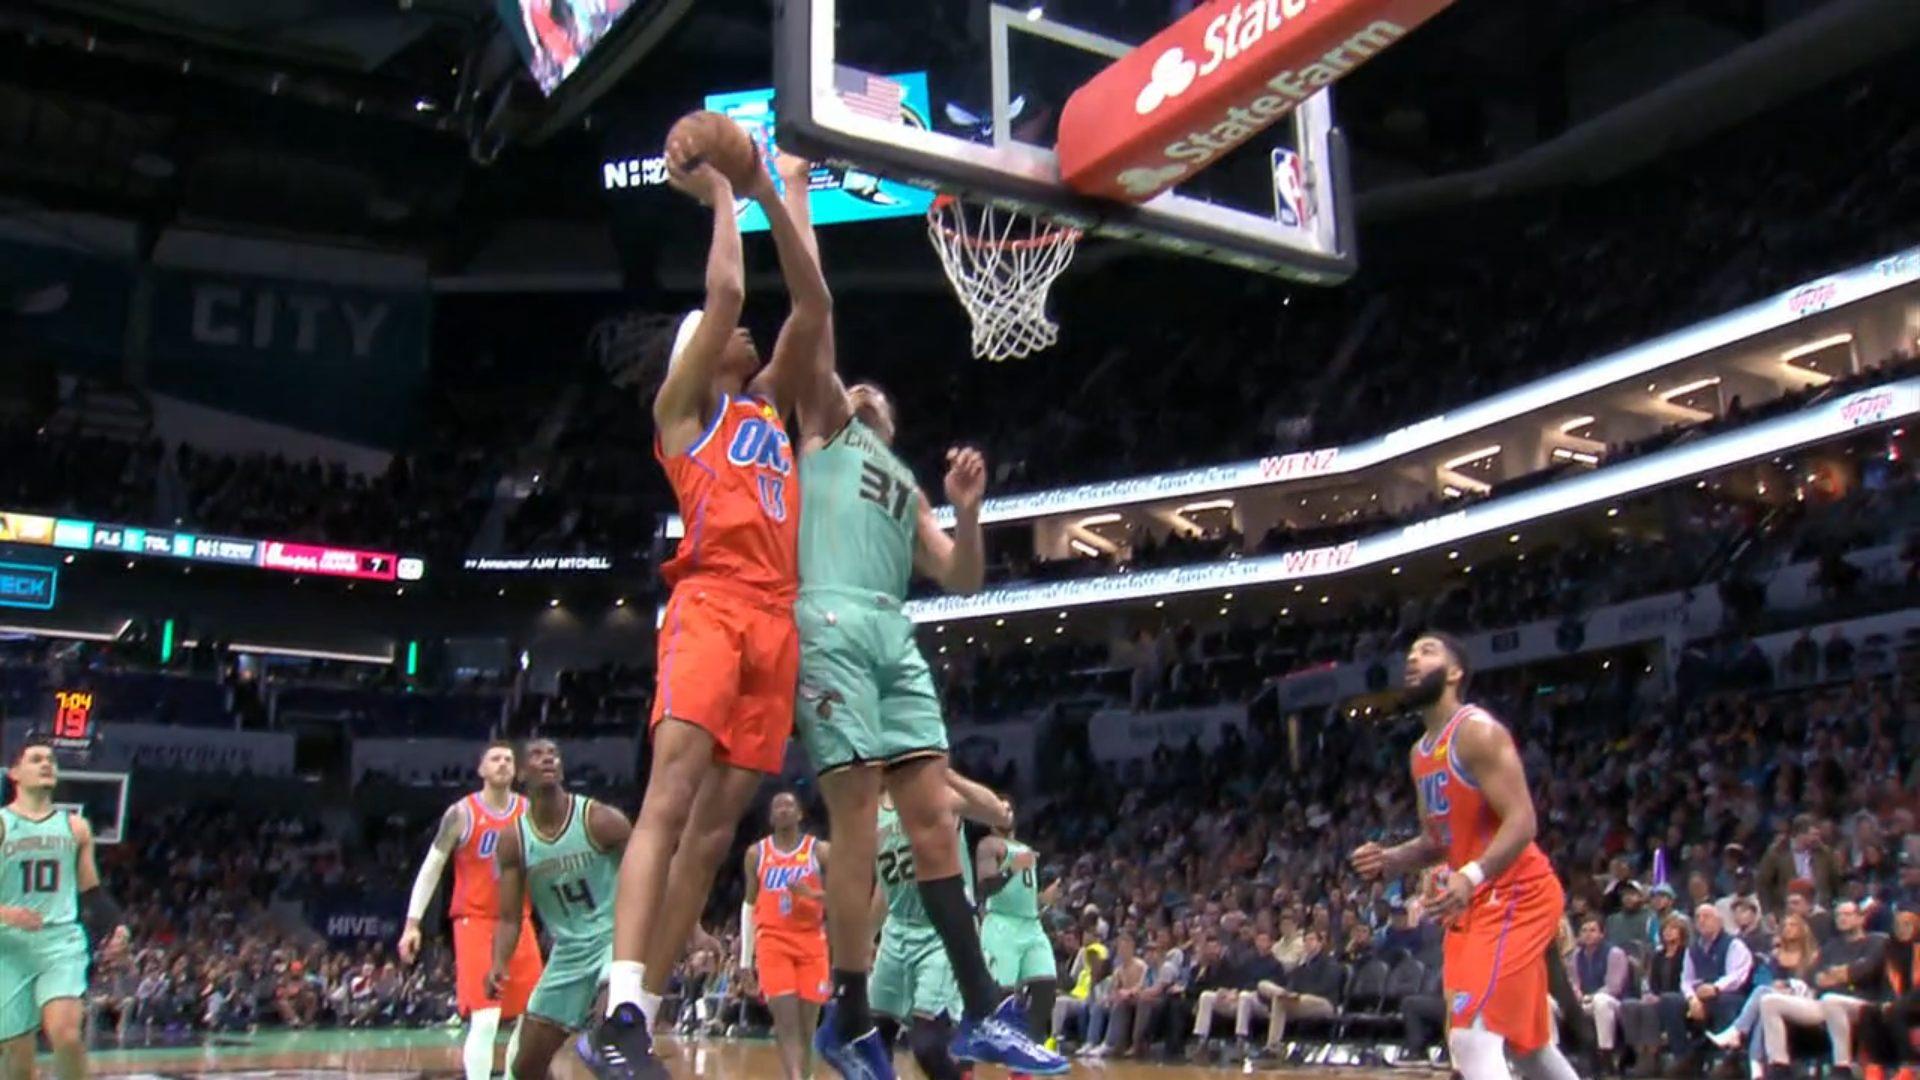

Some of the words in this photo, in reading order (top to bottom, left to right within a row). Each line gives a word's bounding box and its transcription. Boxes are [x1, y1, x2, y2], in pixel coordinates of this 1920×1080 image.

[192, 284, 390, 356] CITY
[1259, 448, 1339, 478] WFNZ
[859, 460, 912, 520] 31
[55, 707, 87, 737] 19
[19, 858, 61, 895] 10
[551, 877, 597, 920] 14
[327, 915, 379, 937] HIVE
